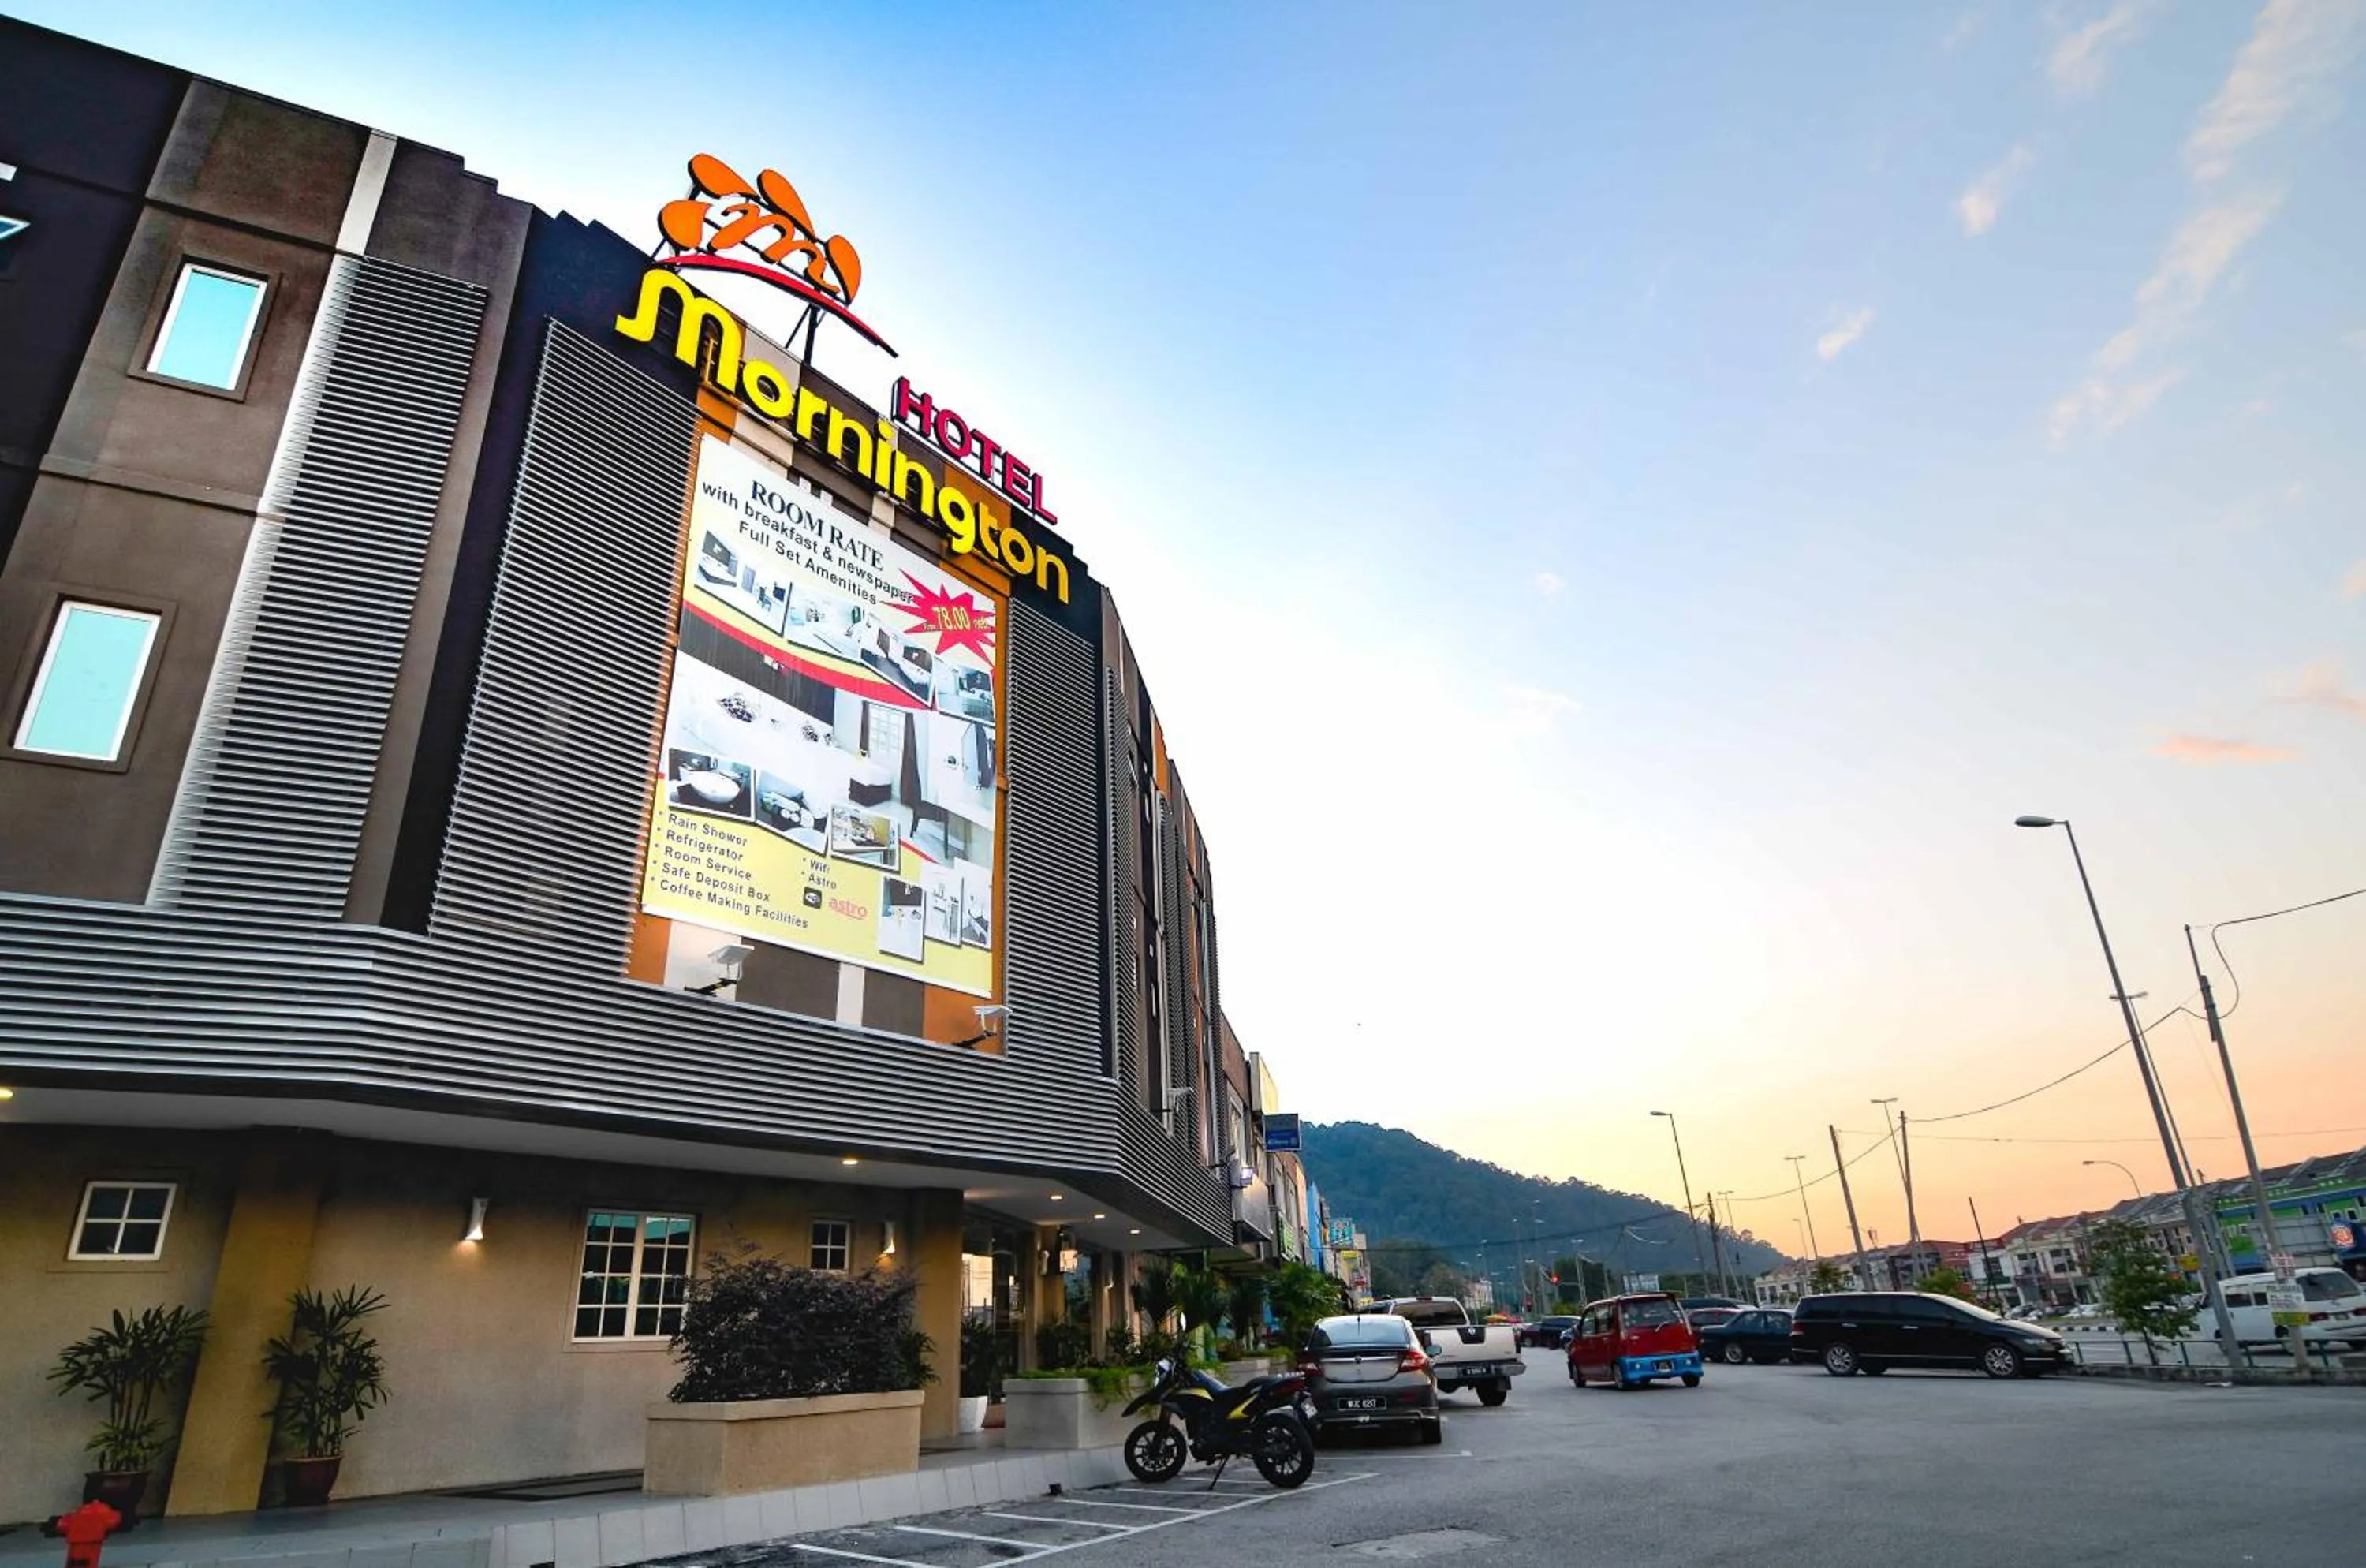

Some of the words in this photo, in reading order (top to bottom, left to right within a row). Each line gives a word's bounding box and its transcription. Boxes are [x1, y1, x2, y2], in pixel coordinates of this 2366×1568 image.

[615, 268, 1070, 605] Mornington
[891, 375, 1058, 525] HOTEL
[702, 481, 738, 510] with
[744, 501, 819, 552] breakfast
[823, 547, 834, 562] &
[838, 555, 913, 605] newspaper
[751, 480, 824, 539] ROOM
[829, 523, 885, 572] RATE
[738, 521, 770, 547] Full
[775, 540, 800, 565] Set
[804, 559, 877, 605] Amenities
[666, 830, 744, 861] Refrigerator
[668, 813, 697, 831] Rain
[703, 823, 748, 846] Shower
[662, 862, 691, 880] Safe
[695, 872, 744, 895] Deposit
[748, 887, 770, 902] Box
[664, 846, 701, 865] Room
[706, 858, 752, 880] Service
[808, 873, 837, 889] Astro
[660, 879, 703, 900] Coffee
[707, 892, 750, 915] Making
[755, 905, 808, 928] Facilities
[829, 898, 867, 917] astro
